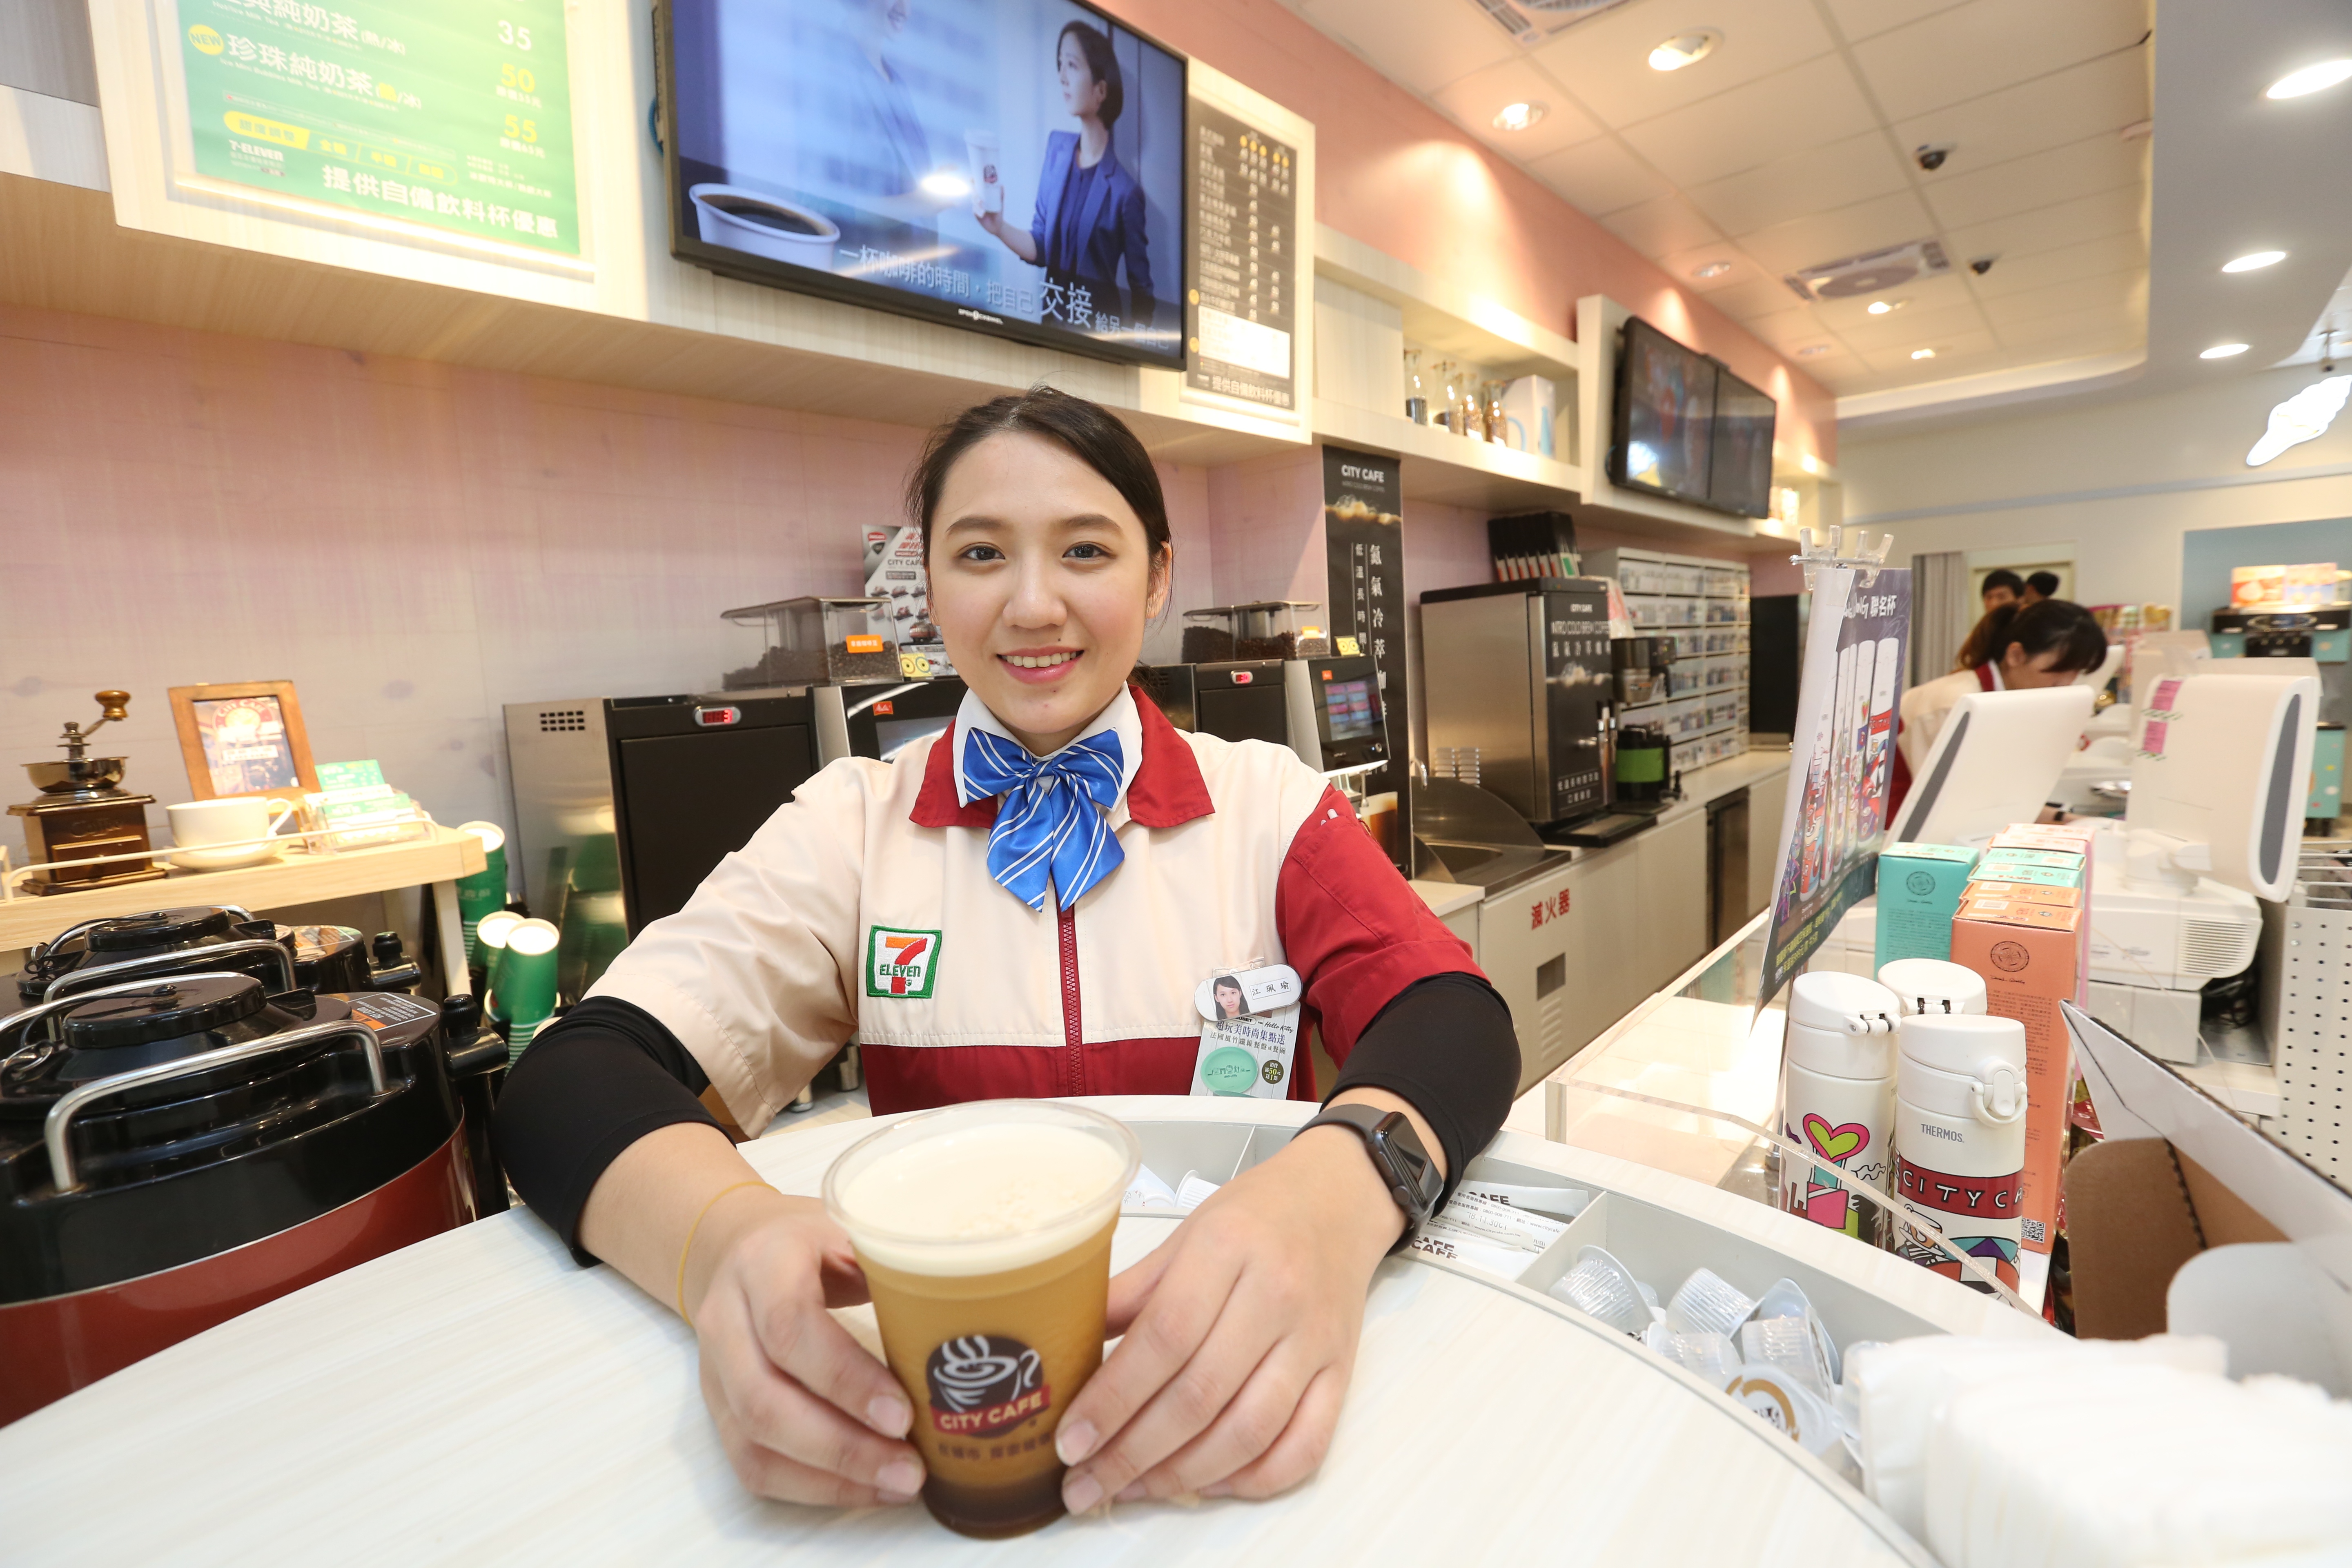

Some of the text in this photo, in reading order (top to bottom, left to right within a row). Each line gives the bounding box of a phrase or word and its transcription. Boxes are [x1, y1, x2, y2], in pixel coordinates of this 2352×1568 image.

[191, 34, 221, 47] NEW
[498, 19, 532, 51] 35
[501, 62, 535, 93] 50
[504, 114, 537, 143] 55
[322, 165, 559, 239] 提供自備飲料杯優惠
[1040, 277, 1093, 329] 交接
[1341, 464, 1385, 483] CITY CAFE
[1532, 888, 1570, 930] 滅火器
[1216, 1021, 1285, 1045] 超玩美時尚集點送
[1921, 1124, 1964, 1143] THERMOS
[1902, 1168, 1983, 1207] CITY
[940, 1392, 1043, 1431] CITY CAFE
